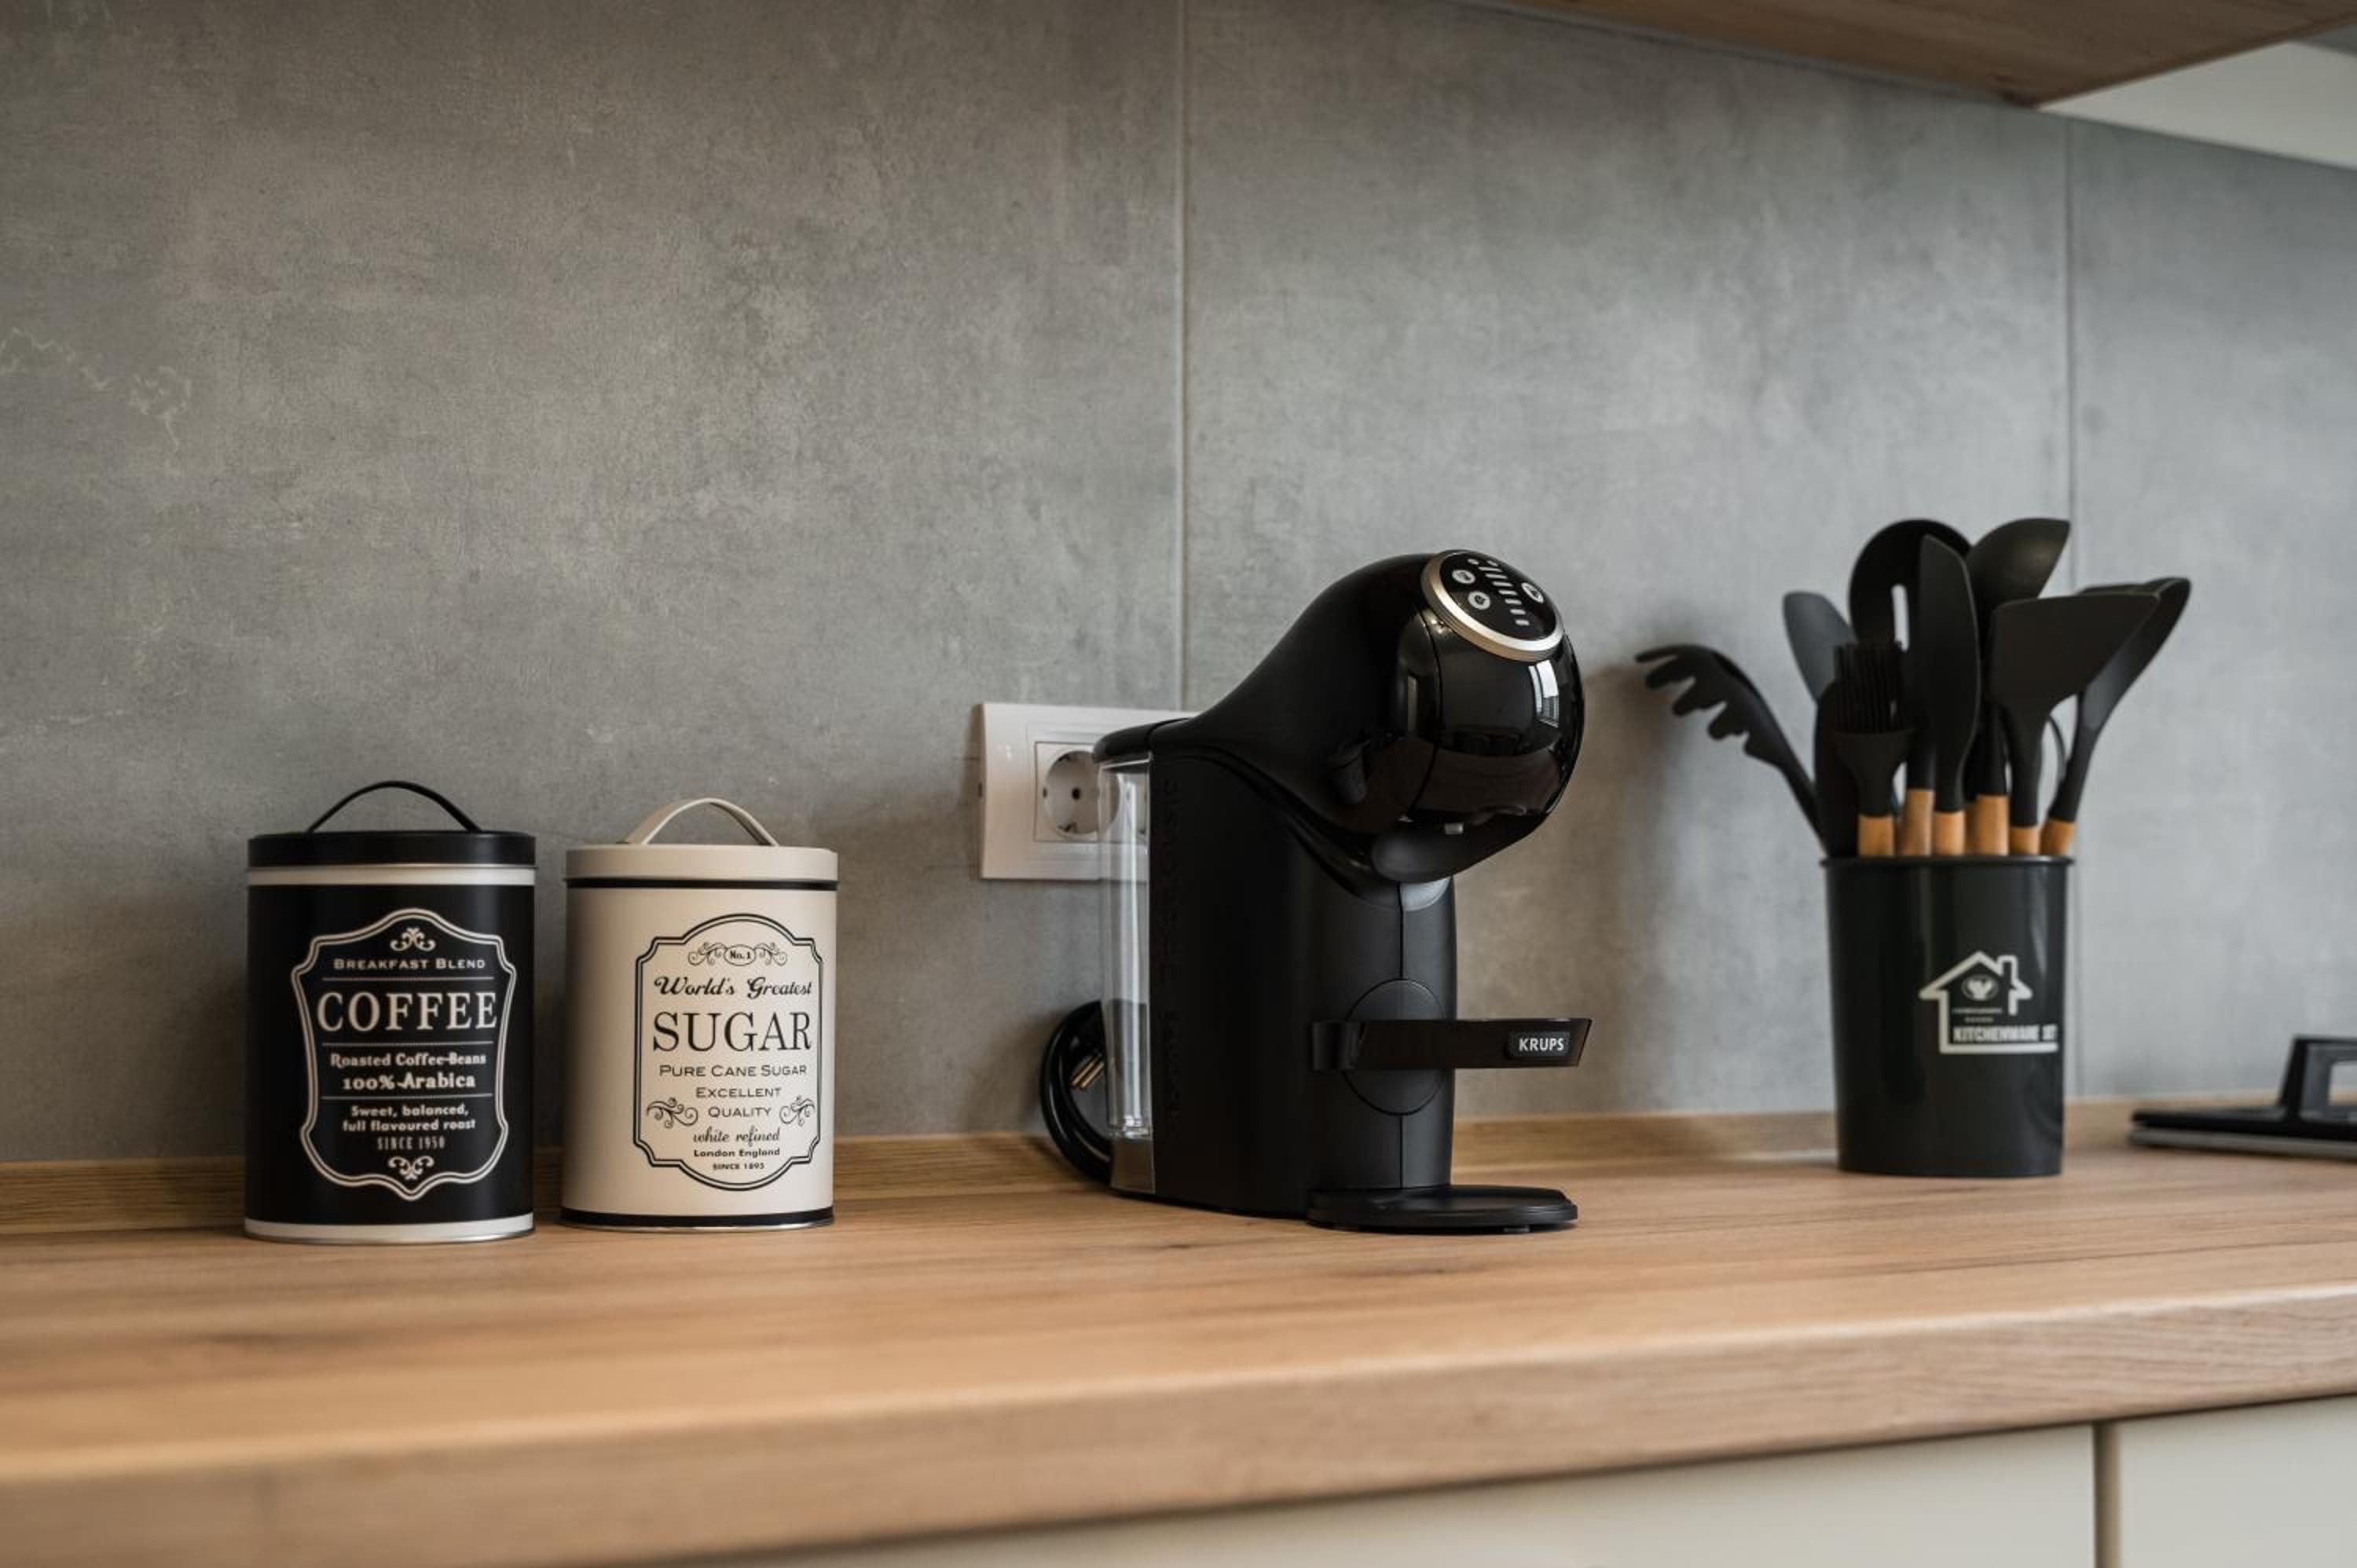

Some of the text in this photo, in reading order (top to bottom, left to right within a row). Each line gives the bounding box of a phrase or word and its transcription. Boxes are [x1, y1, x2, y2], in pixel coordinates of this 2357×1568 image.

[333, 958, 486, 969] BREAKFAST BLEND
[654, 976, 812, 999] World's Greatest
[317, 991, 497, 1031] COFFEE
[653, 1011, 812, 1052] SUGAR
[1519, 1038, 1564, 1052] KRUPS
[331, 1053, 391, 1068] Roasted
[658, 1064, 807, 1077] PURE CANE SUGAR
[695, 1087, 782, 1098] EXCELLENT
[351, 1102, 469, 1117] Sweet, balanced,
[708, 1106, 771, 1119] QUALITY
[343, 1119, 476, 1131] full flavoured roast
[377, 1135, 445, 1151] SINCE 1950
[693, 1125, 780, 1148] white refined
[694, 1148, 780, 1159] London England
